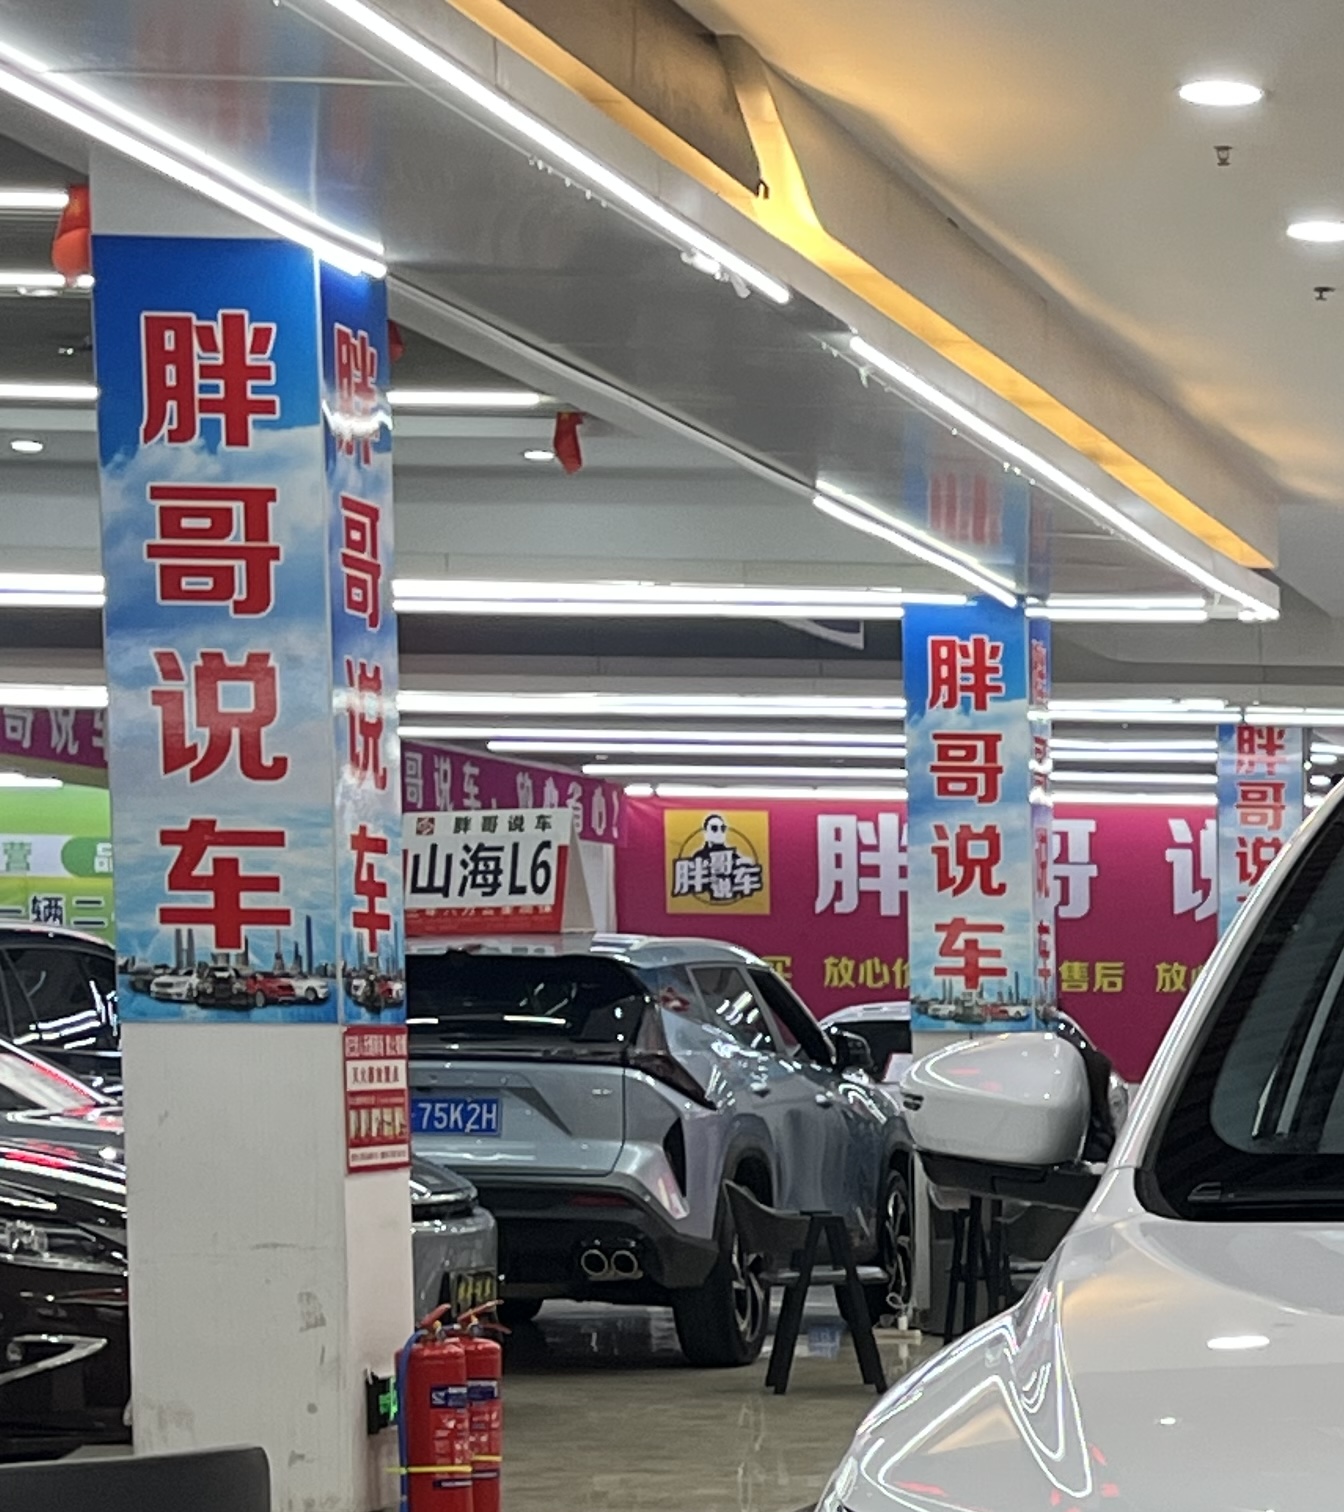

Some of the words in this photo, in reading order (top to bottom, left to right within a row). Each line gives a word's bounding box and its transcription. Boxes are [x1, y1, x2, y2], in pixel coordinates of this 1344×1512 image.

[139, 309, 292, 951] 胖哥说车
[334, 322, 392, 954] 胖哥说车
[410, 840, 553, 898] 山海L6
[453, 814, 553, 834] 胖哥说车
[673, 849, 763, 900] 胖哥说车
[927, 634, 1008, 991] 胖哥说车
[1234, 723, 1287, 902] 胖哥说
